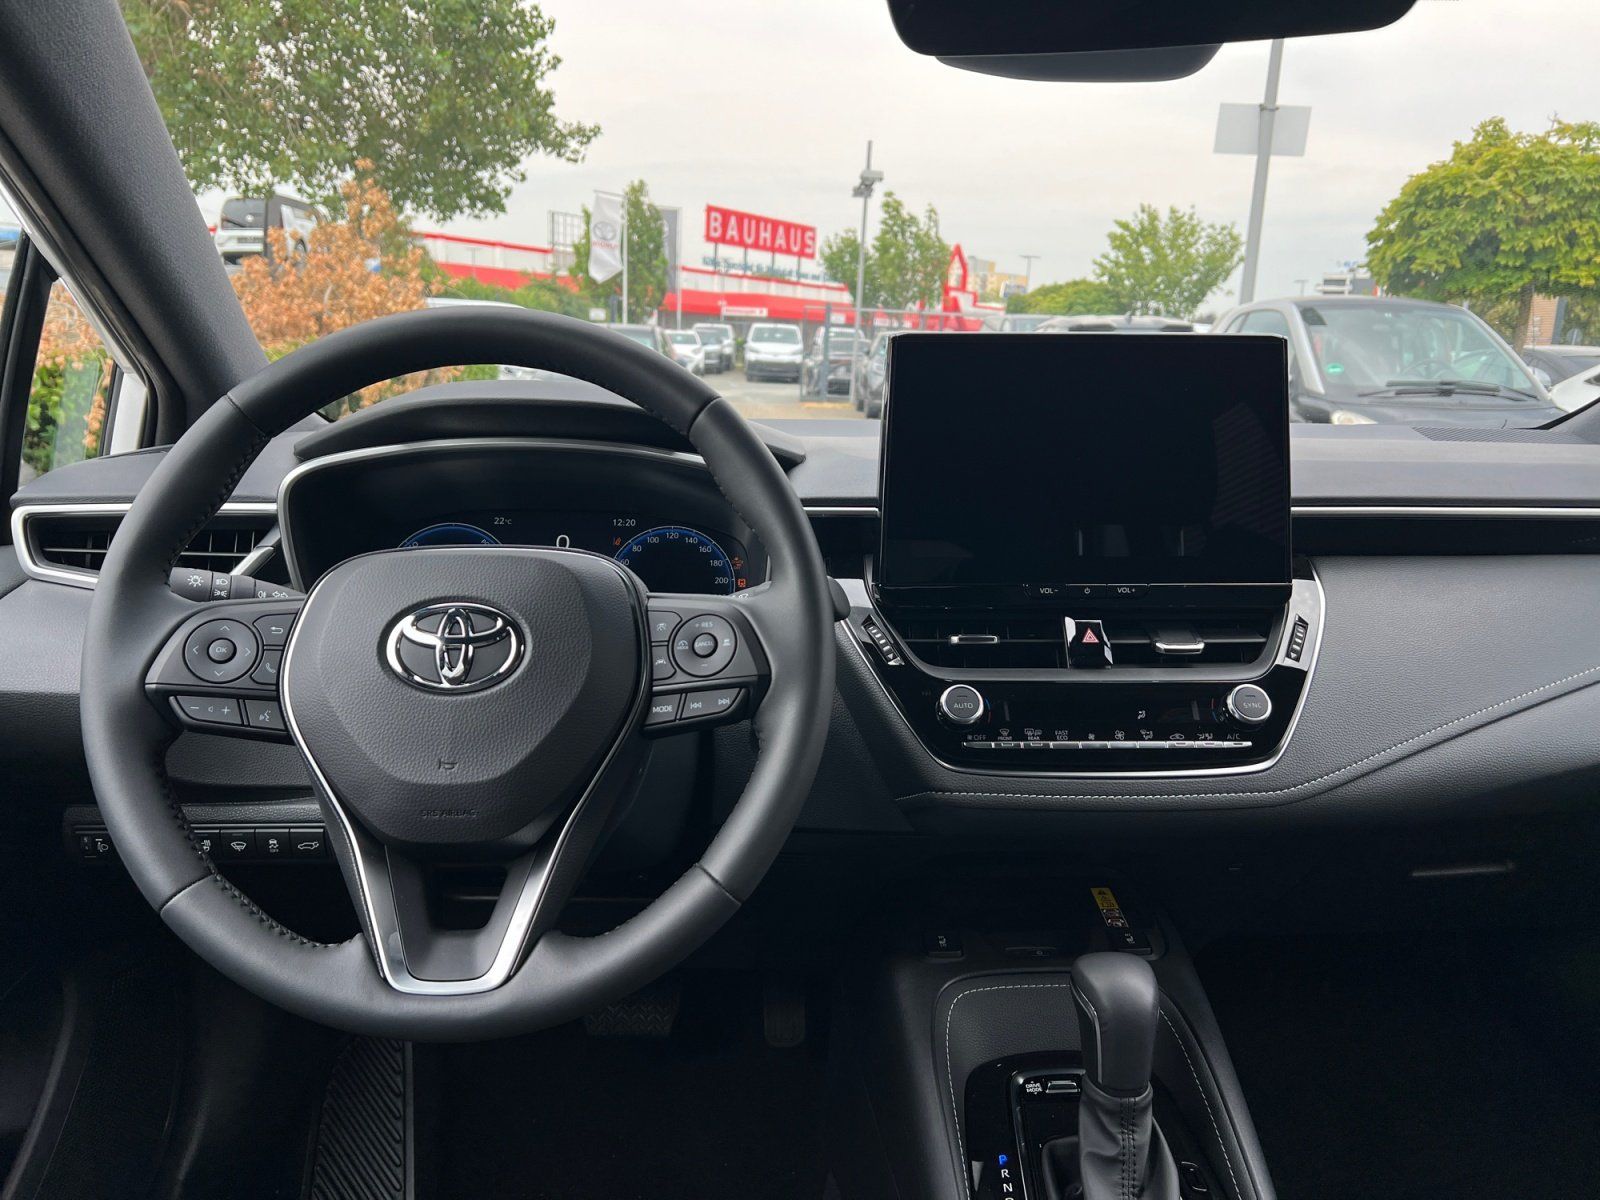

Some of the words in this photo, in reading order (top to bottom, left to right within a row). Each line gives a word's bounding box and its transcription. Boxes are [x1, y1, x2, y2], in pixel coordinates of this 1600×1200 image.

[709, 210, 815, 254] BAUHAUS
[612, 518, 636, 527] 12:20
[653, 705, 673, 713] MODE
[999, 1154, 1007, 1165] P
[1001, 1168, 1010, 1178] R
[1003, 1183, 1013, 1192] N
